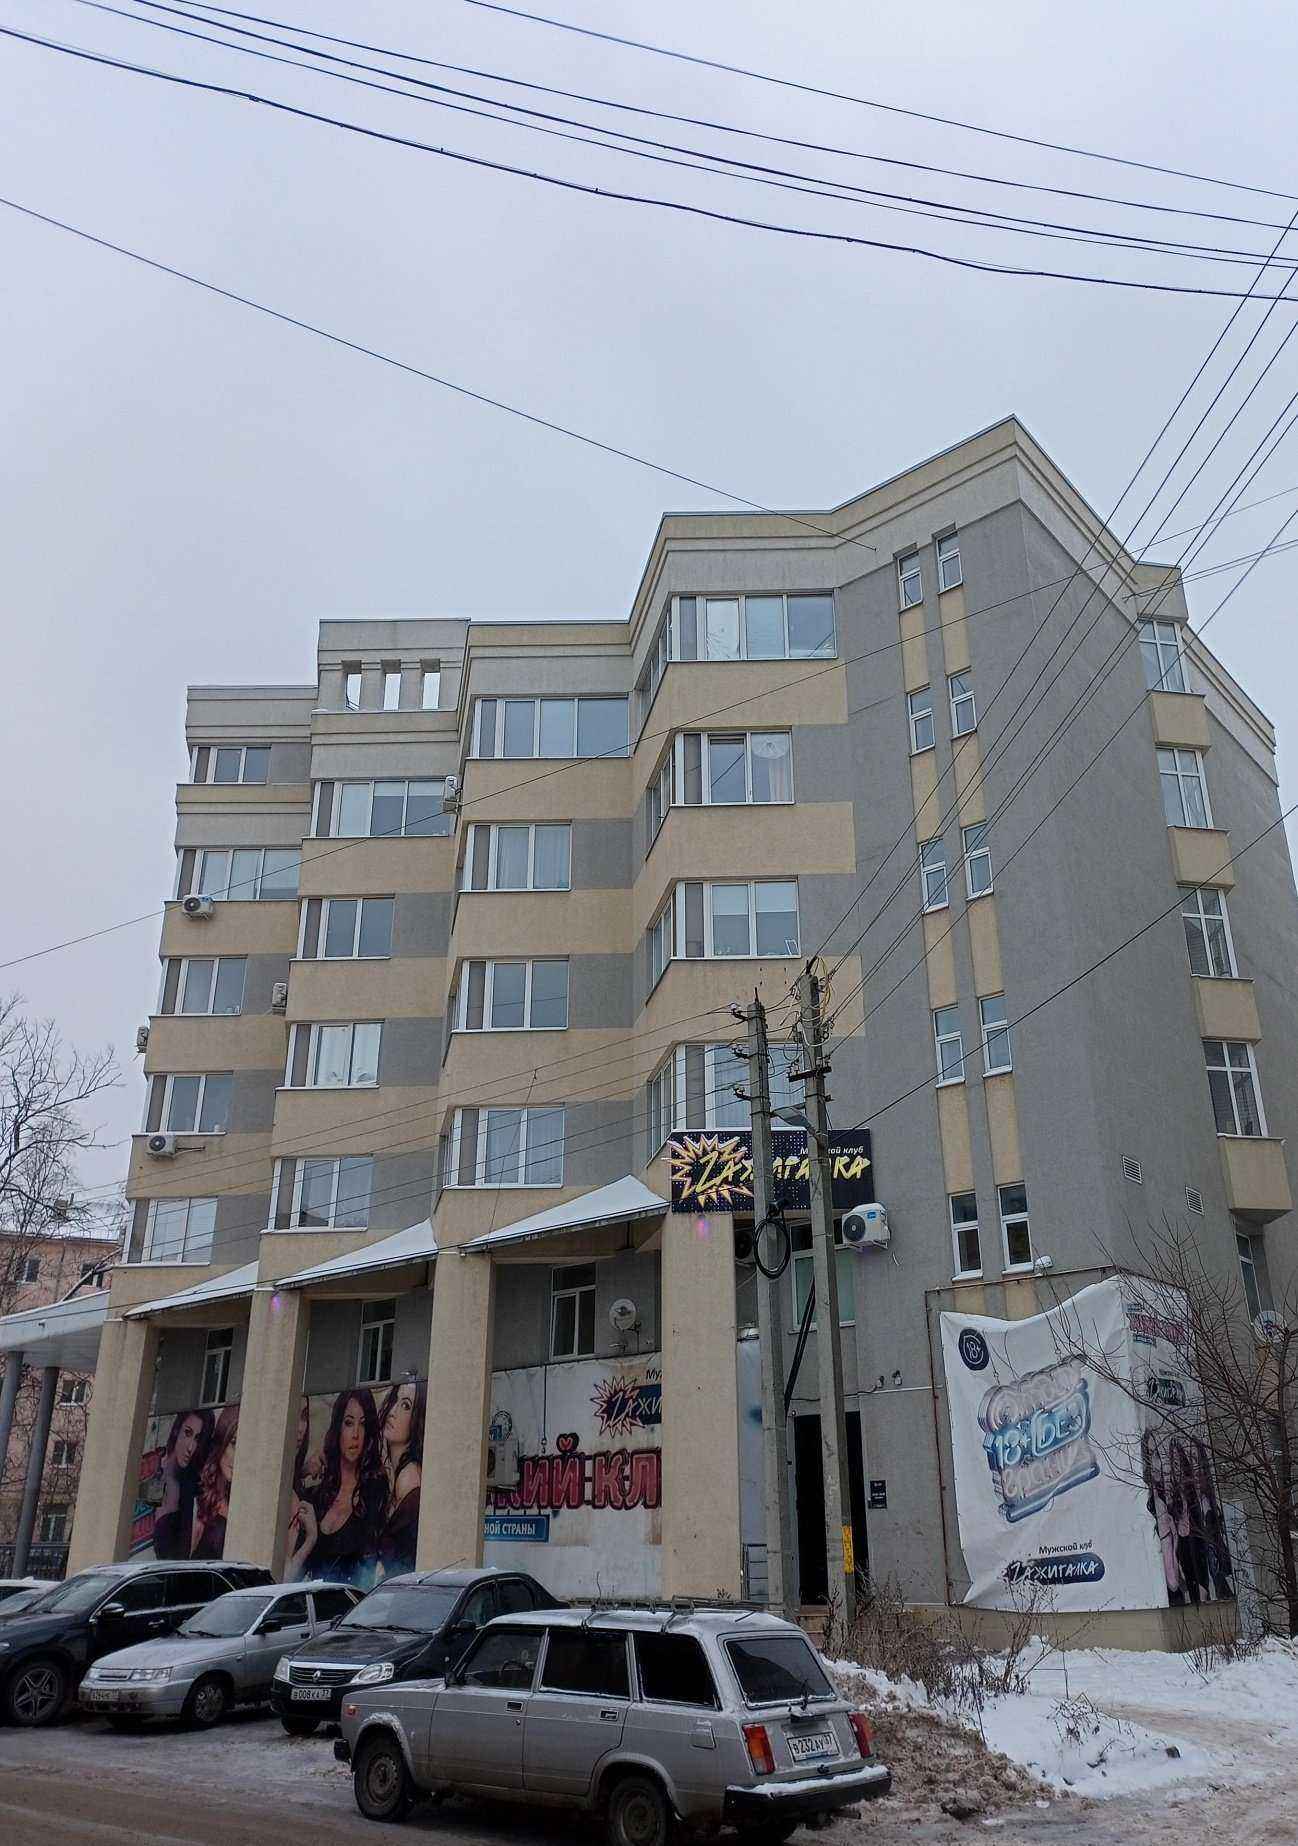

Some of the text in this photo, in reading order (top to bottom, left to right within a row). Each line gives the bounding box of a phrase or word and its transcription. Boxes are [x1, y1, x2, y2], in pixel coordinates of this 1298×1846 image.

[843, 1145, 864, 1156] клуб
[646, 1368, 662, 1382] Му
[502, 1522, 536, 1535] СТРАНЫ
[1039, 1539, 1093, 1556] Мужской клуб
